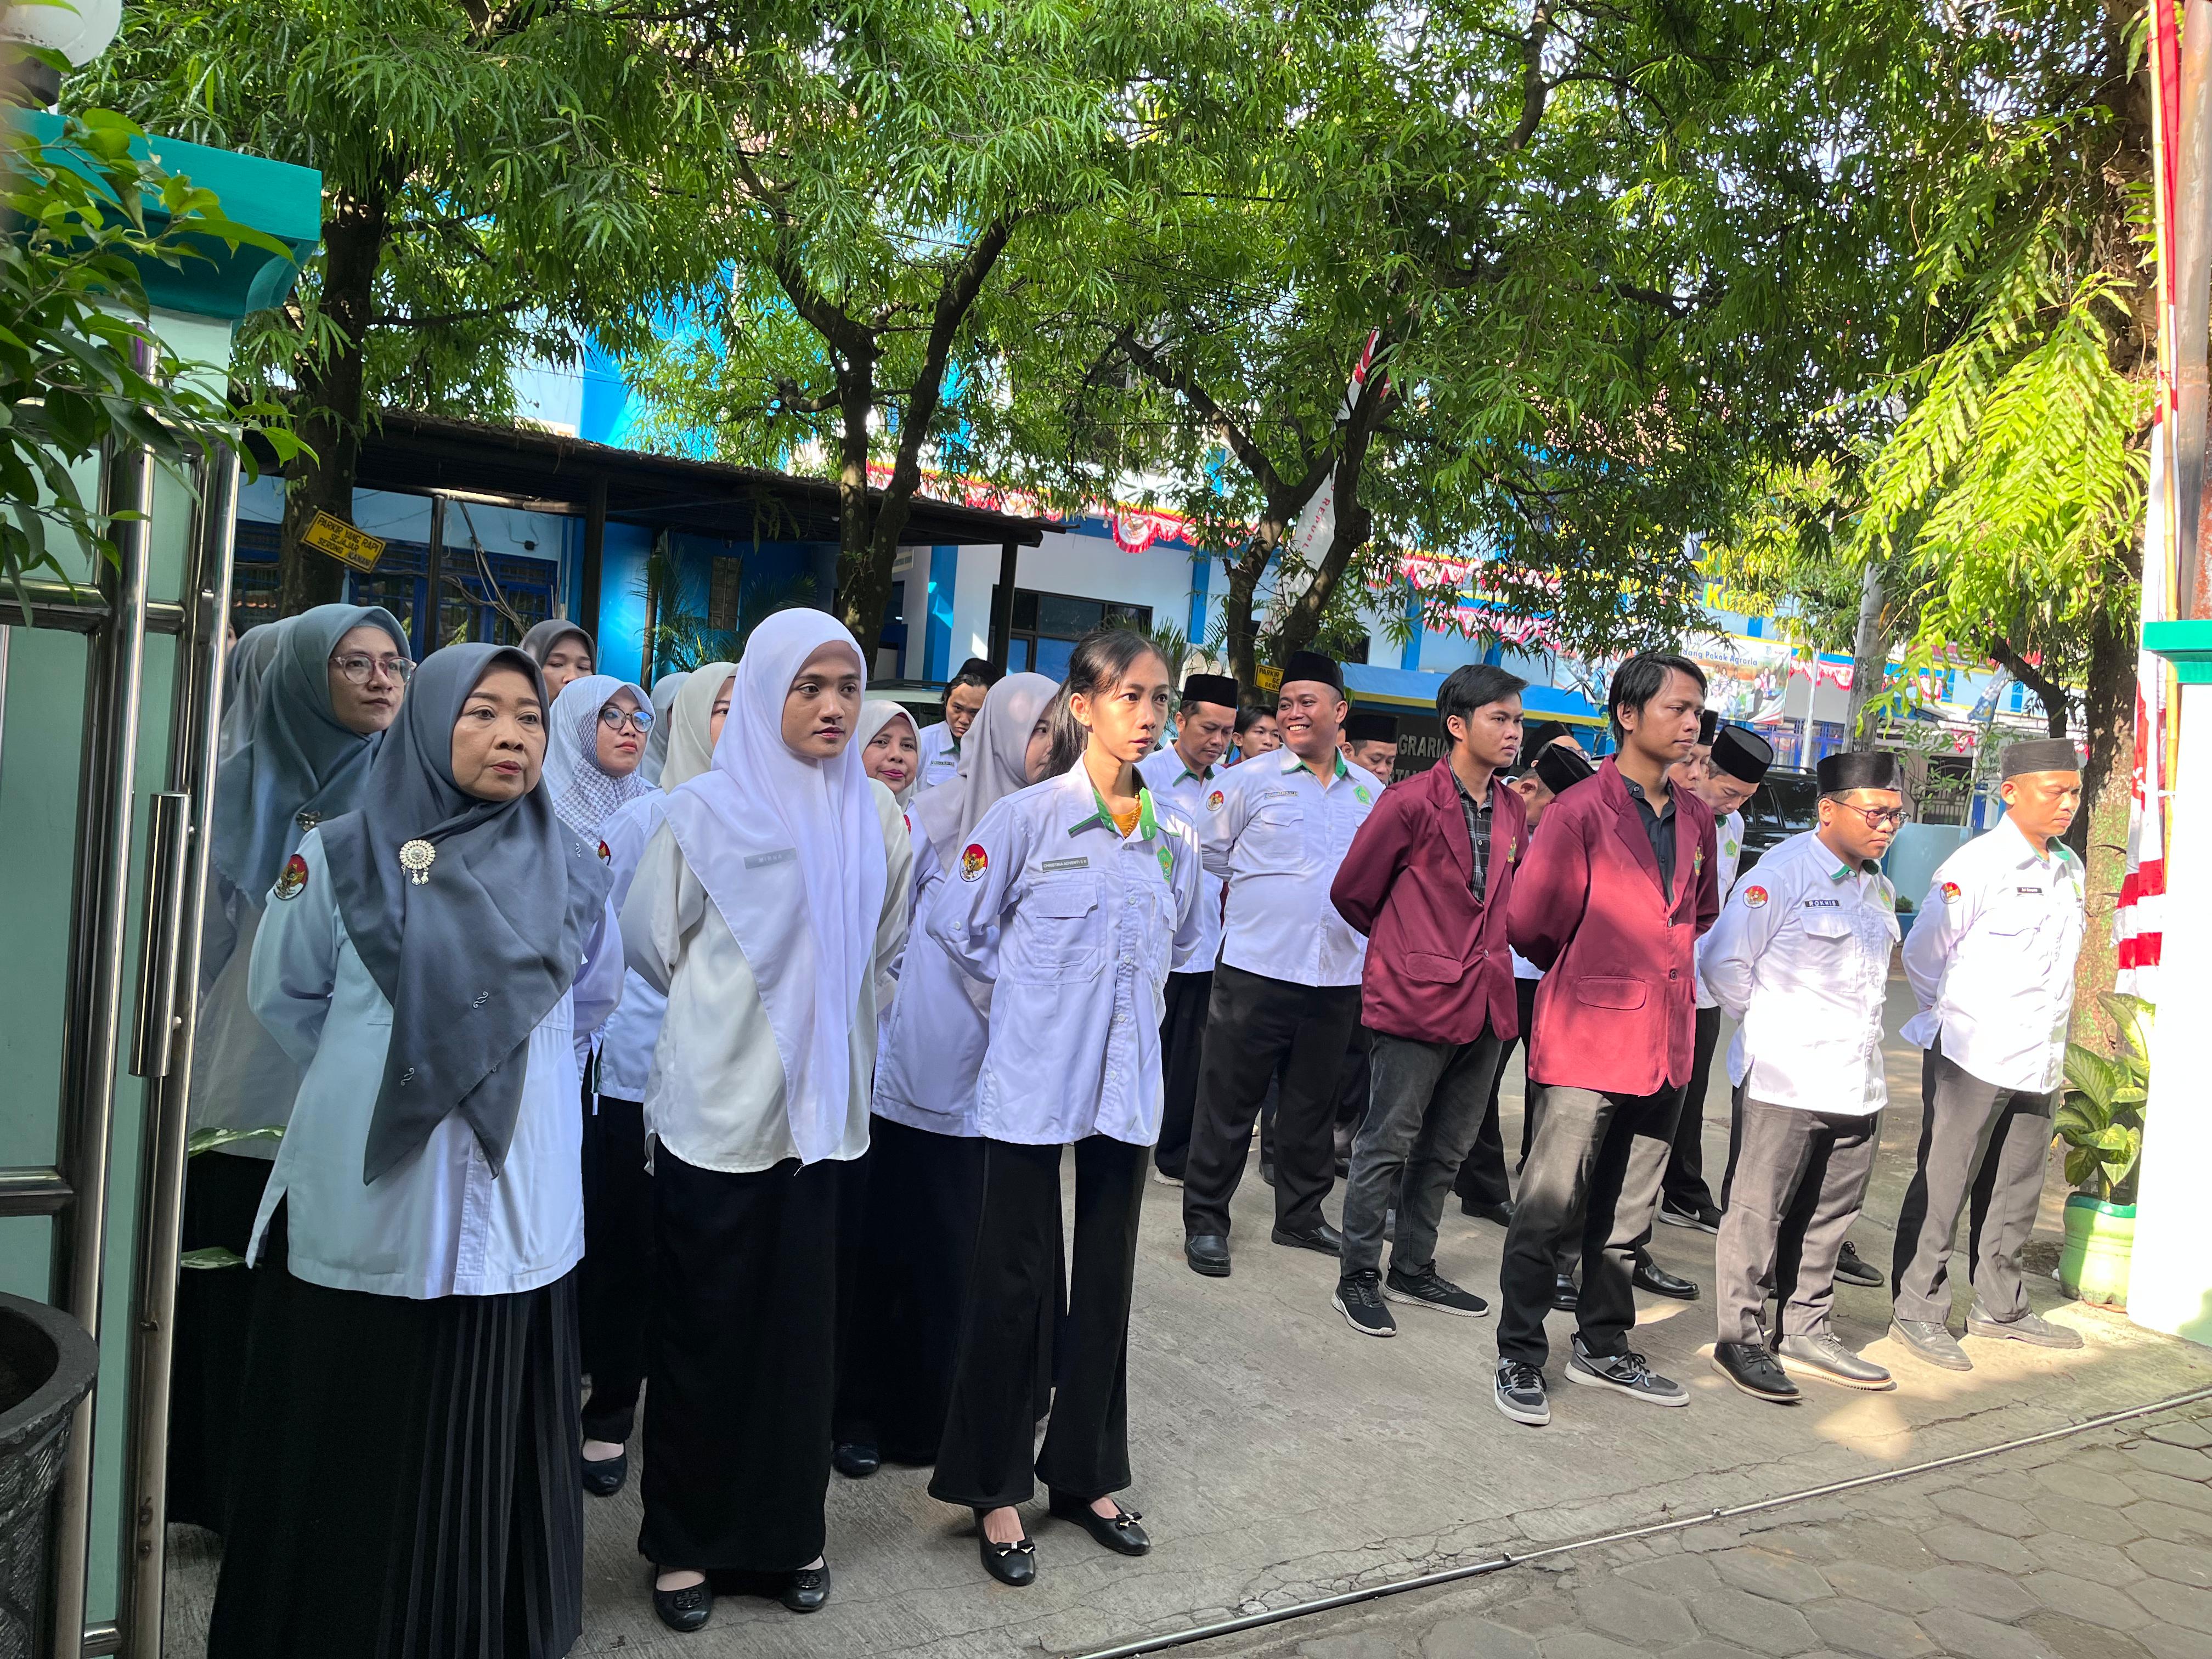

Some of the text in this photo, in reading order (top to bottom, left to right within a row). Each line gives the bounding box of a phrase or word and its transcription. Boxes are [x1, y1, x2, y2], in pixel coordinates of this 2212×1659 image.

[317, 517, 379, 553] PARKIR YANG RAPI
[330, 533, 359, 553] SEJAJAR
[317, 537, 343, 554] SERONG
[1705, 651, 1728, 662] Pokok
[1729, 655, 1758, 665] Agraria
[1259, 668, 1280, 678] PARKIR
[1397, 733, 1449, 759] GRARIA
